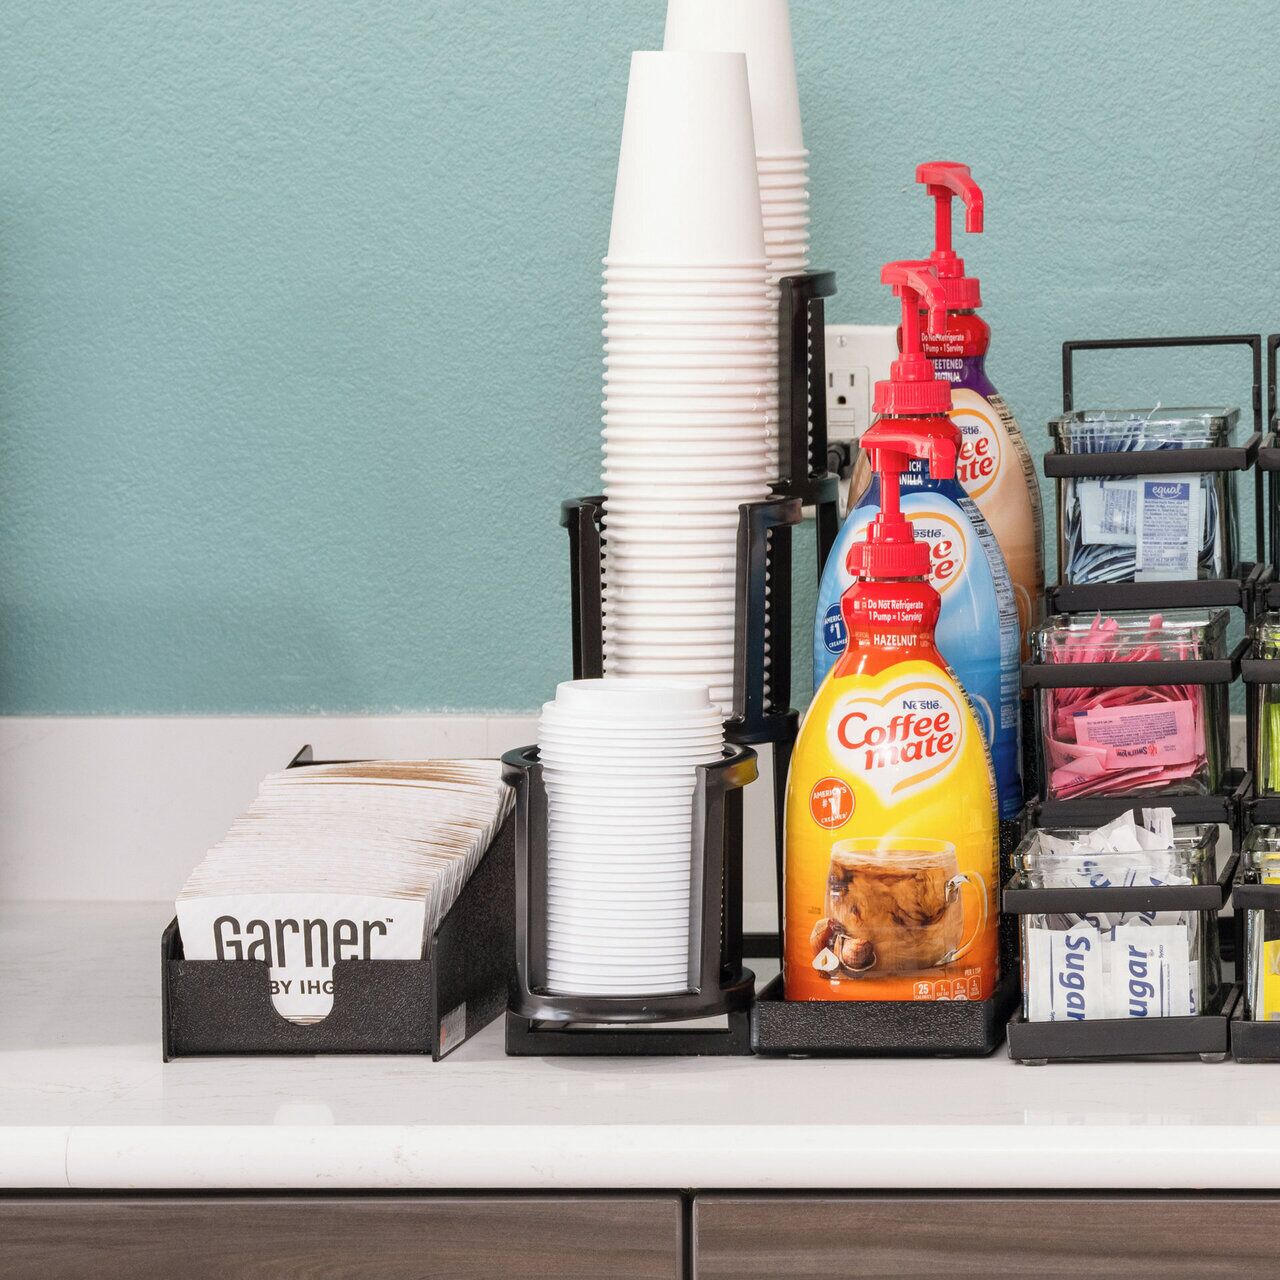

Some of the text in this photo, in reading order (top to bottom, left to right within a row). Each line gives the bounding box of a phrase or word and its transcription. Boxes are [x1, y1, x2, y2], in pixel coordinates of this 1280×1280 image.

[926, 343, 939, 354] Pump
[946, 343, 964, 354] Serving
[933, 358, 964, 370] EETENED
[958, 425, 979, 435] stlé
[908, 461, 922, 472] ICH
[956, 455, 993, 483] ate
[1152, 483, 1182, 498] equal
[913, 528, 942, 538] estlé
[868, 599, 876, 609] Do
[878, 599, 890, 609] Not
[891, 599, 924, 611] Refrigerate
[824, 613, 843, 624] AMERIC
[873, 611, 891, 623] Pump
[901, 611, 923, 622] Serving
[829, 623, 841, 639] #1
[873, 634, 917, 646] HAZELNUT
[837, 711, 950, 750] Coffee
[864, 732, 954, 770] mate
[813, 785, 847, 801] AMERIC'S
[821, 787, 841, 817] #1
[1058, 934, 1091, 1020] Sugar
[1128, 944, 1155, 1018] ugar
[269, 980, 335, 995] BY IHG
[918, 983, 929, 995] 25
